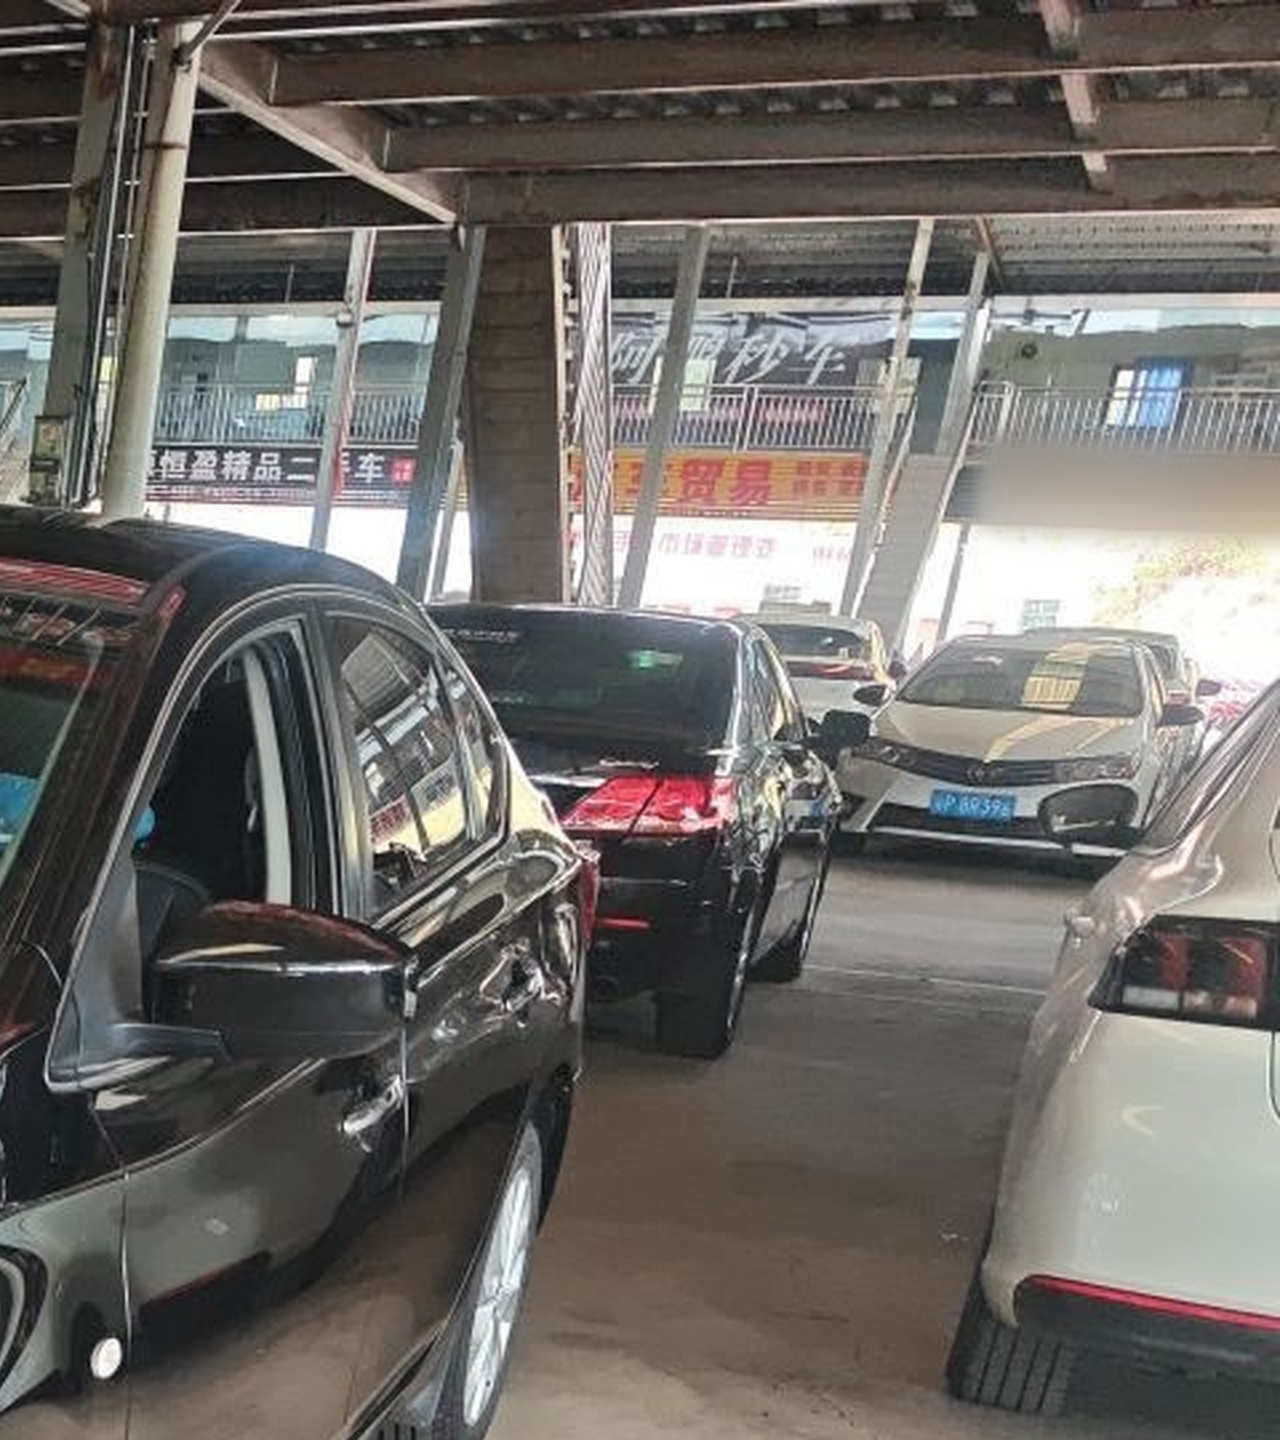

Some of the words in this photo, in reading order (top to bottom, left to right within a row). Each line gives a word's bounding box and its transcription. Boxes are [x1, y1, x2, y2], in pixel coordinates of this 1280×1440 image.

[146, 450, 386, 482] 恒盈精品二车
